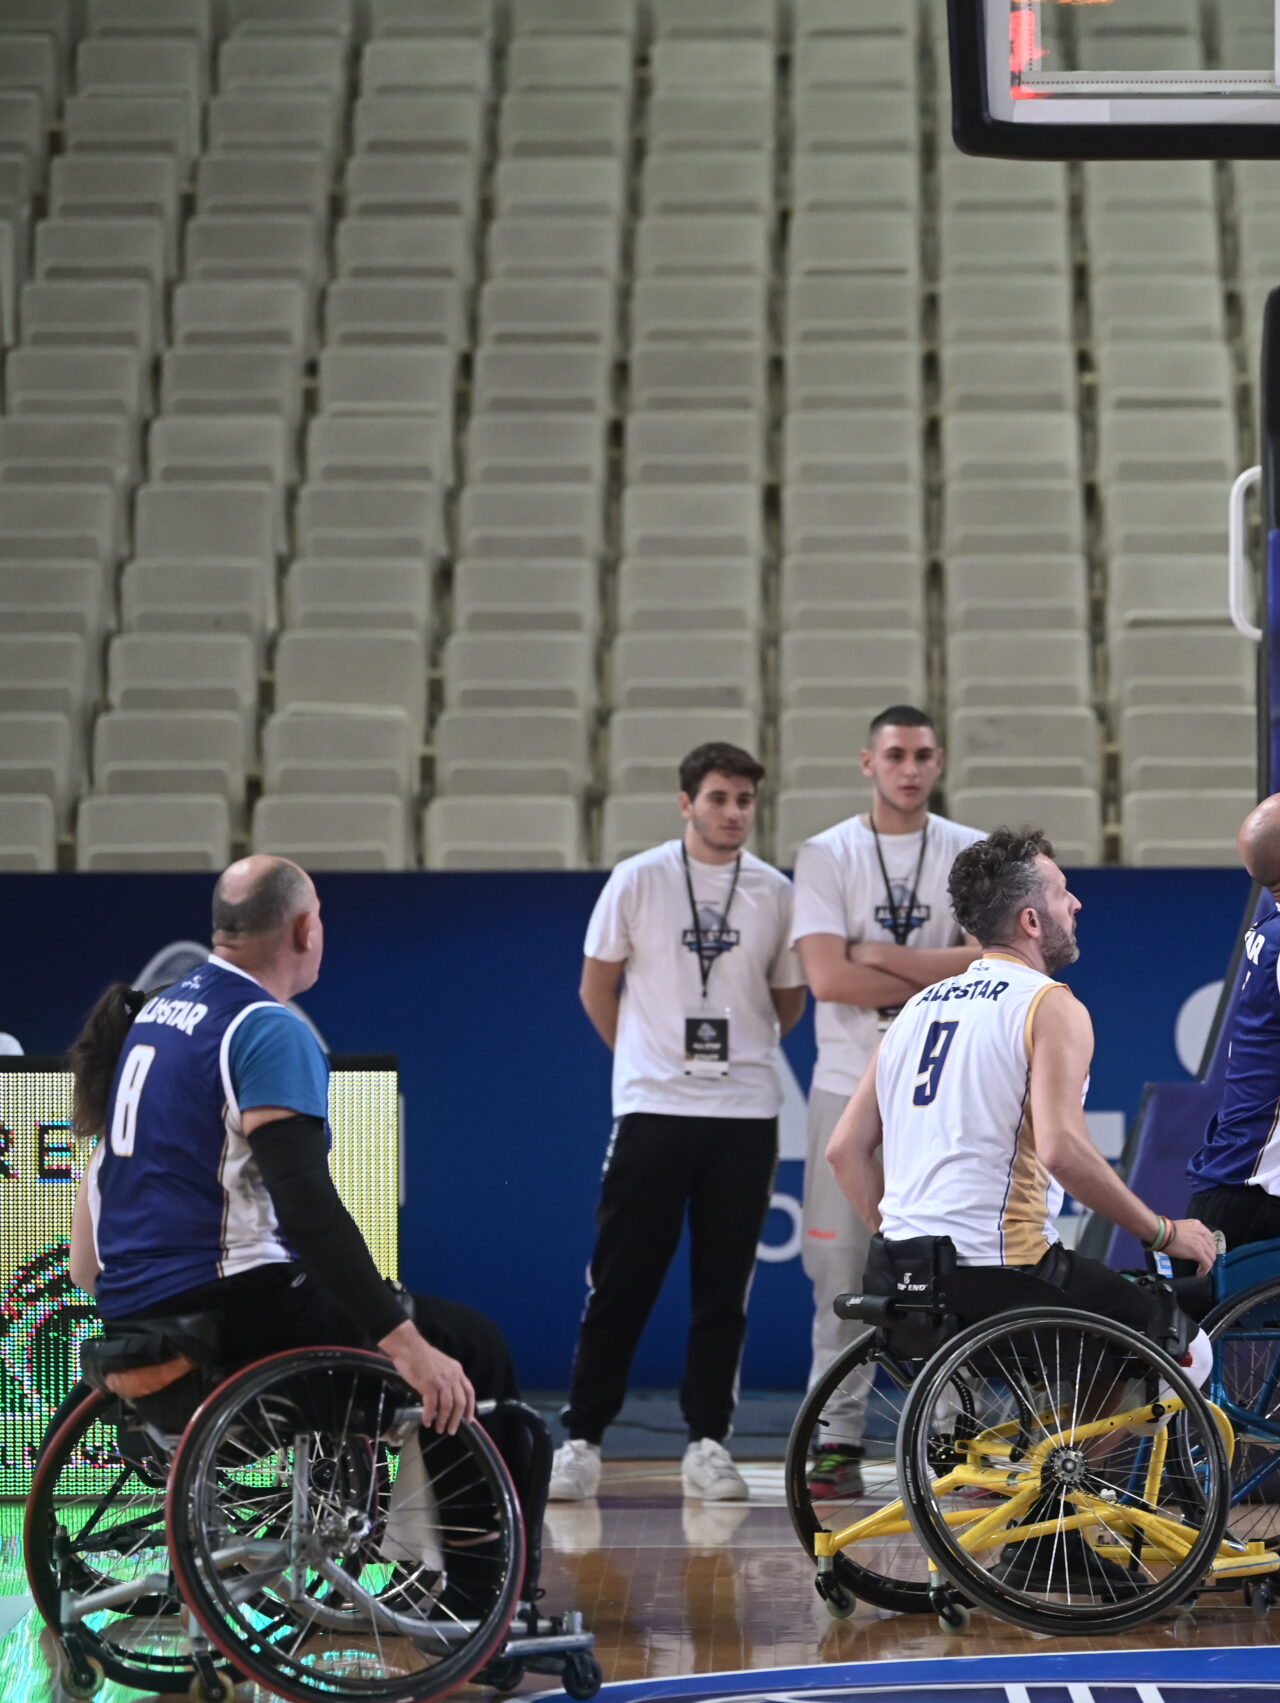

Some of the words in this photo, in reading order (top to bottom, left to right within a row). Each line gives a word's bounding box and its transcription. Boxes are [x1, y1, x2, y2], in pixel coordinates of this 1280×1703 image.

[954, 980, 1010, 1002] STAR
[110, 1044, 157, 1158] 8
[912, 1020, 960, 1108] 9
